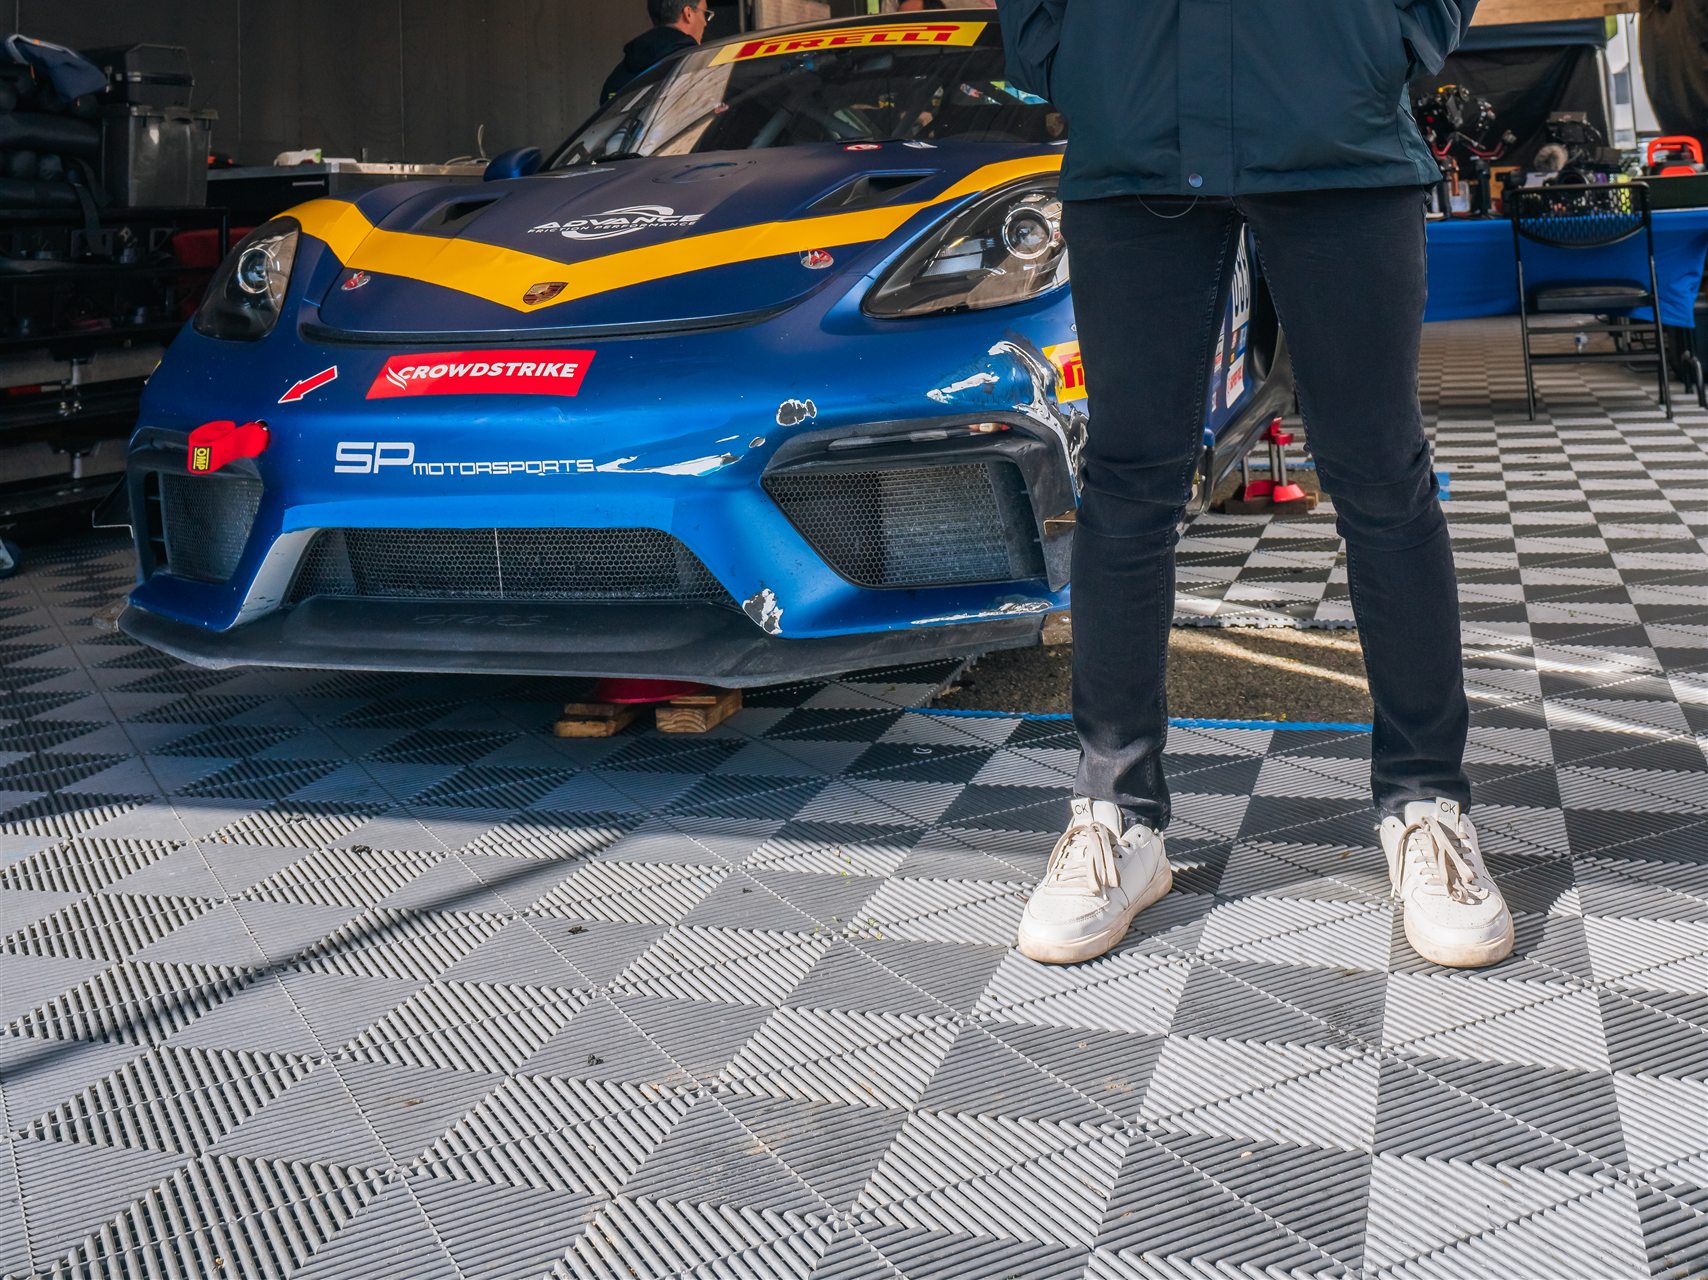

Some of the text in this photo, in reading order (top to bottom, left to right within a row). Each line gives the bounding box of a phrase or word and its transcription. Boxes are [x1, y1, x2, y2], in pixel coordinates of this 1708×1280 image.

[734, 25, 960, 59] PIRELLI
[527, 220, 697, 234] FRICTION PERFORMANCE
[533, 213, 705, 230] ADVANCE
[398, 362, 579, 380] CROWDSTRIKE
[196, 447, 207, 471] OMP
[334, 441, 594, 476] SP MOTORSPORTS
[1075, 803, 1089, 815] CK
[1441, 802, 1456, 814] CK
